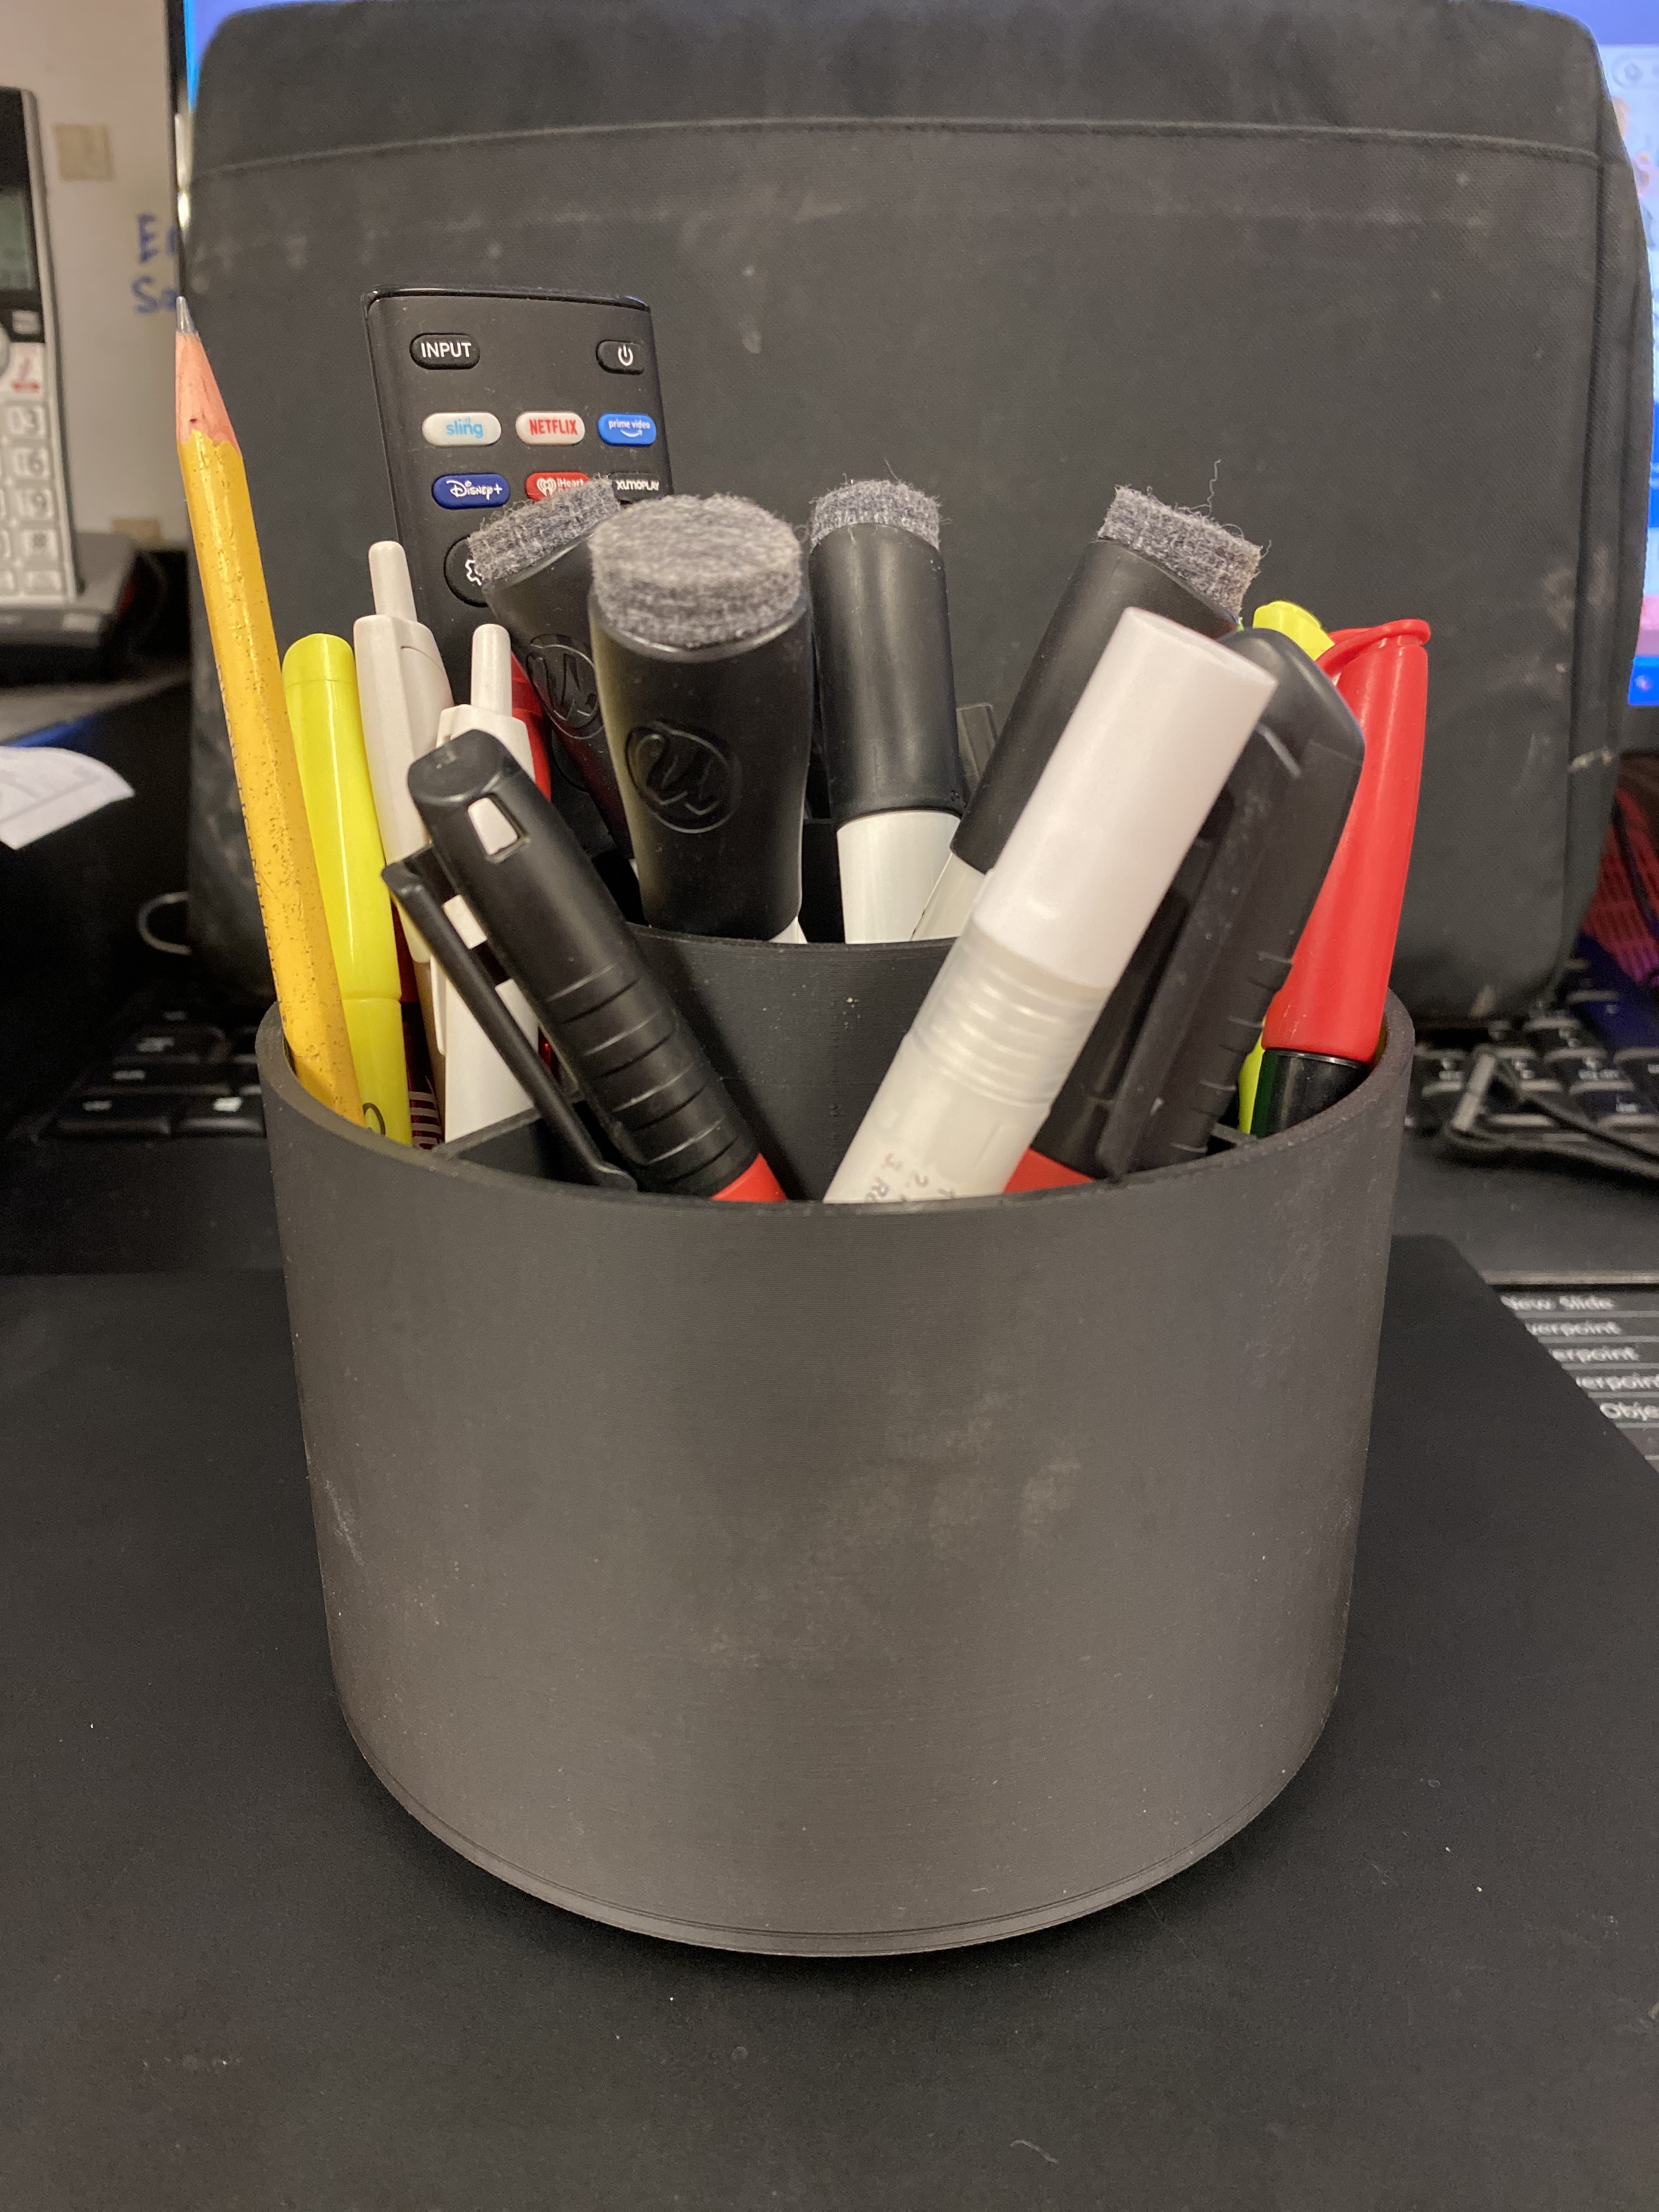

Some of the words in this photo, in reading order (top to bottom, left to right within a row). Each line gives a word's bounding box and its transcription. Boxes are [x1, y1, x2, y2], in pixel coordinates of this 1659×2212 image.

[420, 342, 472, 358] INPUT
[446, 420, 483, 439] sling
[529, 419, 578, 436] NETFLIX
[608, 419, 630, 430] prime
[631, 419, 651, 429] video
[556, 477, 584, 488] iHeart
